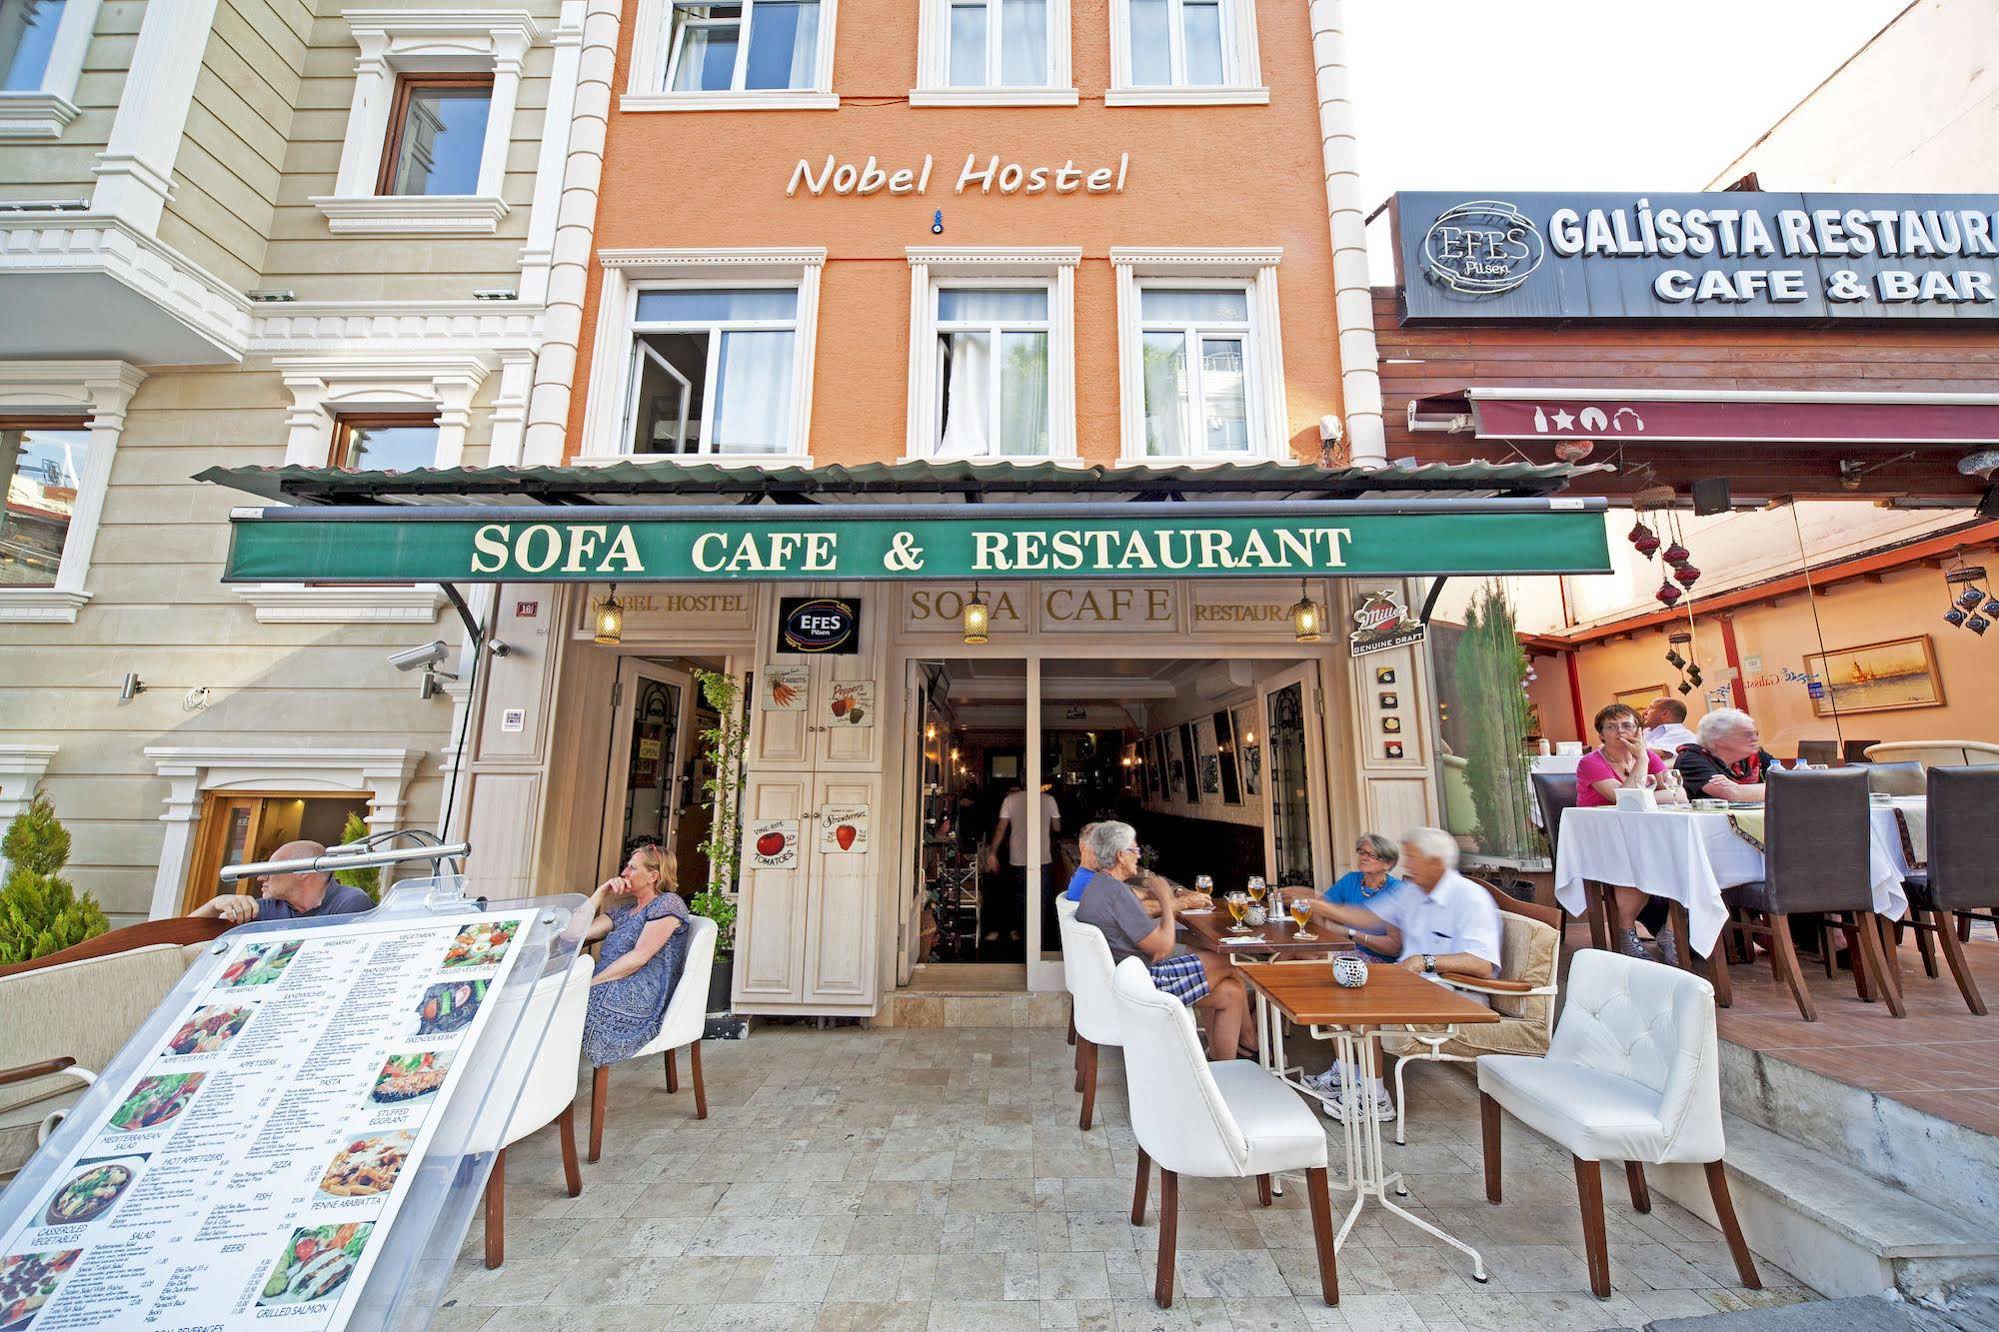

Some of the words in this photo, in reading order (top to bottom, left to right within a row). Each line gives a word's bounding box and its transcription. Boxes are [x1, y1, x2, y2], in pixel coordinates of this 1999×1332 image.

[786, 153, 933, 196] Nobel
[955, 152, 1130, 196] Hostel
[1437, 227, 1530, 259] EFES
[1464, 261, 1510, 277] Pilsen
[1654, 270, 1808, 301] CAFE
[1826, 270, 1872, 301] &
[1875, 270, 1997, 301] BAR
[471, 524, 645, 573] SOFA
[691, 532, 838, 572] CAFE
[883, 531, 925, 572] &
[970, 528, 1352, 572] RESTAURANT
[592, 595, 656, 612] NBEL
[666, 593, 748, 612] HOSTEL
[1046, 588, 1173, 621] CAFE
[800, 615, 840, 630] EFES
[1363, 607, 1407, 626] Miller
[1353, 639, 1393, 654] GENUINE
[1395, 633, 1423, 645] DRAFT
[832, 684, 865, 699] Peppers
[755, 850, 794, 866] TOMATOES
[376, 1108, 410, 1117] STUFFED
[369, 1116, 409, 1126] EGGPLANT
[101, 1132, 162, 1144] MEDITERRANEAN
[113, 1142, 137, 1150] SALAD
[162, 1157, 182, 1166] HOT
[182, 1152, 225, 1162] APPETIZERS
[271, 1160, 292, 1169] PIZZA
[255, 1192, 273, 1200] FISH
[311, 1200, 340, 1210] PENNE
[340, 1197, 382, 1208] ARABIATTA
[37, 1225, 88, 1237] CASSEROLED
[130, 1231, 156, 1241] SALAD
[30, 1234, 82, 1246] VEGETABLES
[220, 1243, 246, 1253] BEERS
[256, 1306, 293, 1319] GRILLED
[292, 1303, 329, 1316] SALMON
